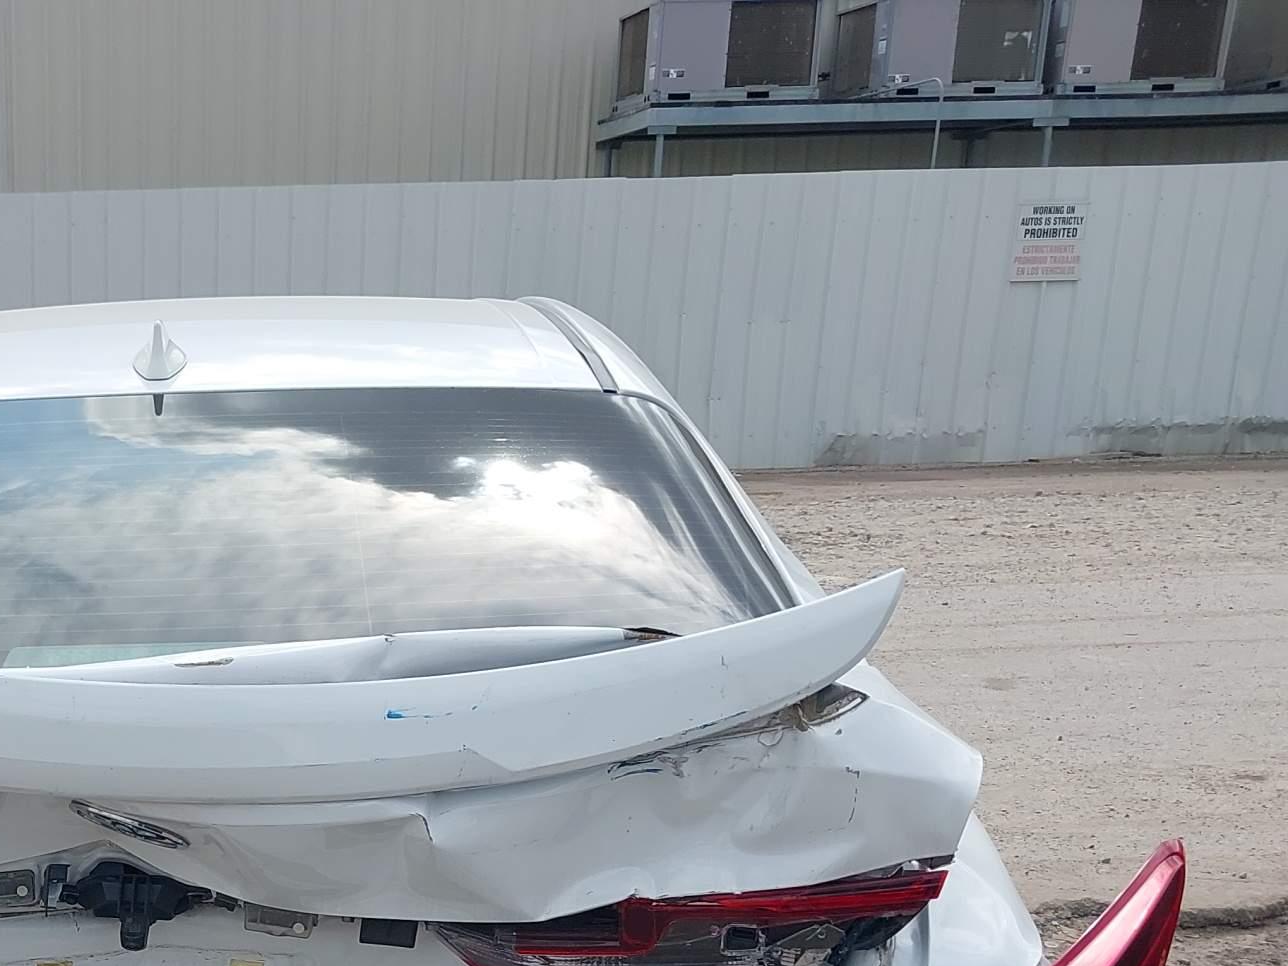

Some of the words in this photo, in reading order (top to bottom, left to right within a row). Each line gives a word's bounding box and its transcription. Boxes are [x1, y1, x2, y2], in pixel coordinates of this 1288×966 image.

[1032, 205, 1064, 215] WORKING
[1066, 205, 1076, 214] ON
[1020, 217, 1043, 226] AUTOS
[1044, 217, 1052, 226] IS
[1053, 216, 1085, 226] STRICTLY
[1023, 227, 1078, 239] PROHIBITED
